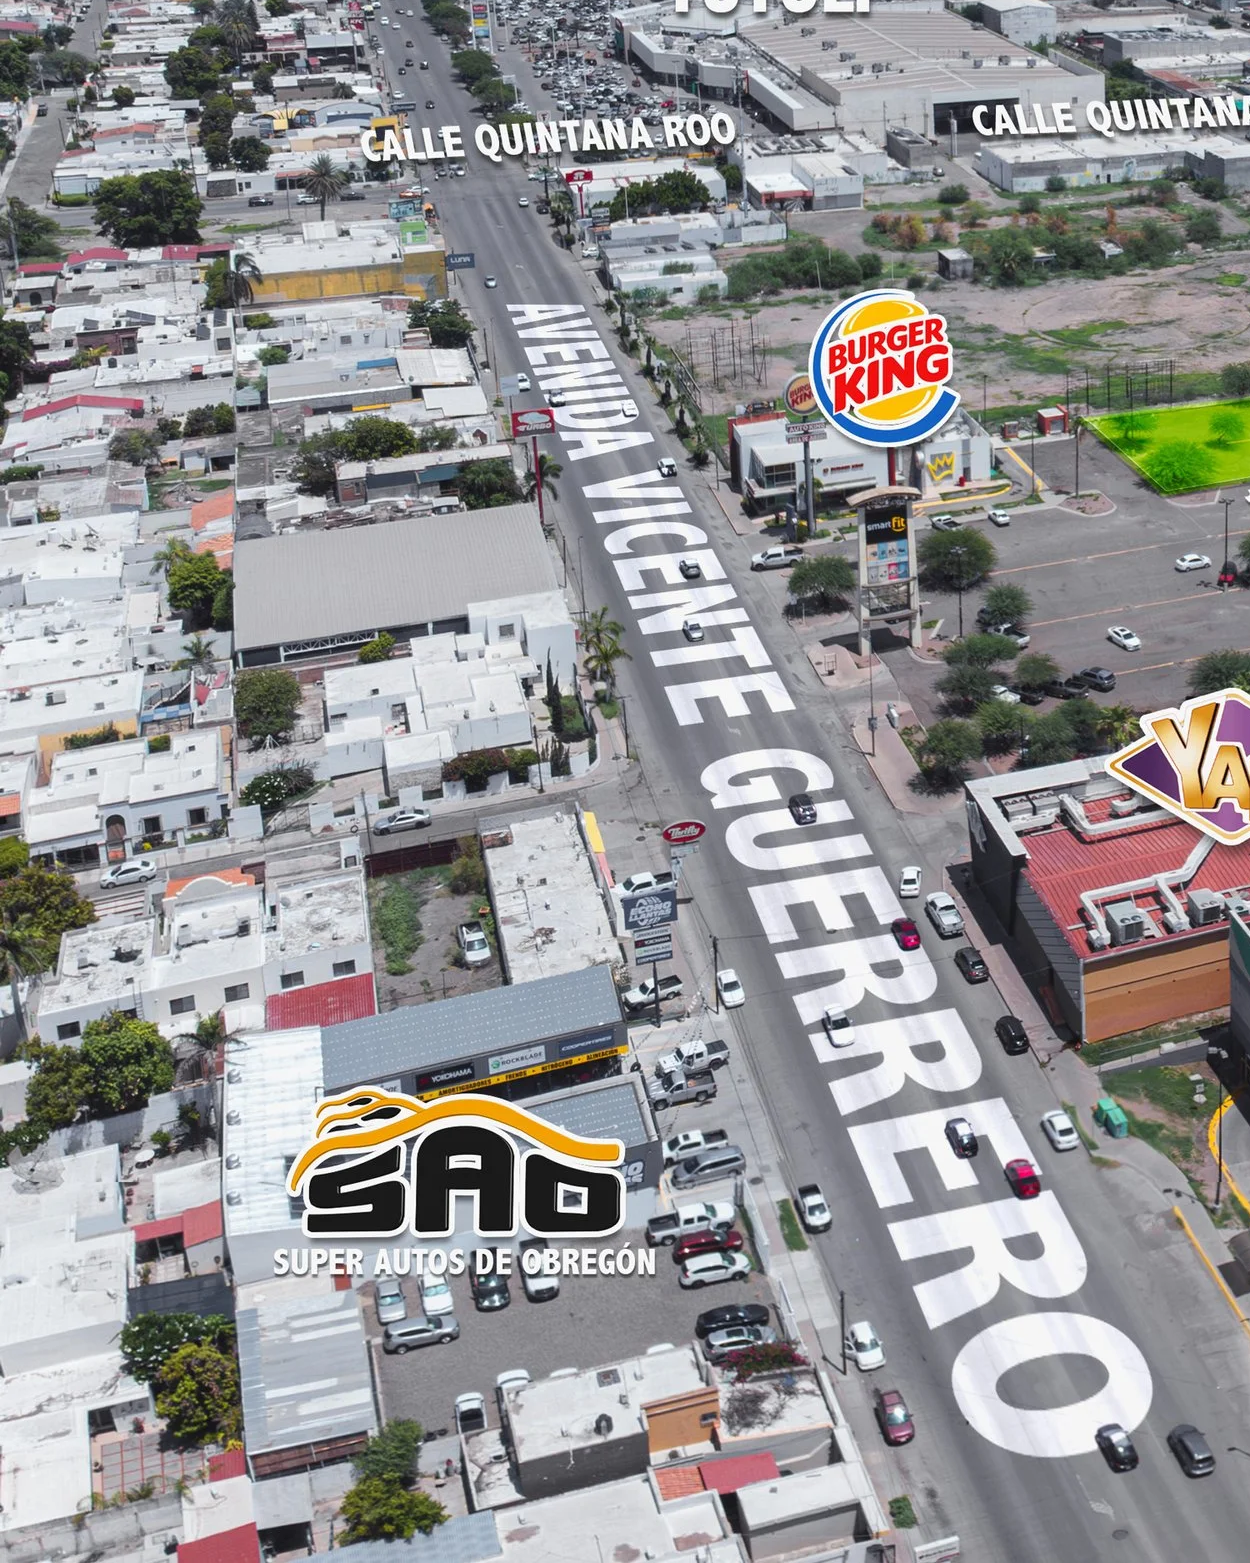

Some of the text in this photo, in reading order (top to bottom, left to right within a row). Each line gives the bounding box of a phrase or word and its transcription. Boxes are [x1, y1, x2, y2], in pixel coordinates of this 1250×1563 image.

[866, 517, 905, 531] smart fit
[668, 825, 700, 838] Thrifty
[628, 907, 672, 922] LLANTAS
[630, 900, 671, 916] ECONO
[501, 1051, 543, 1066] ROCKBLADE
[431, 1068, 473, 1083] YOKOHAMA
